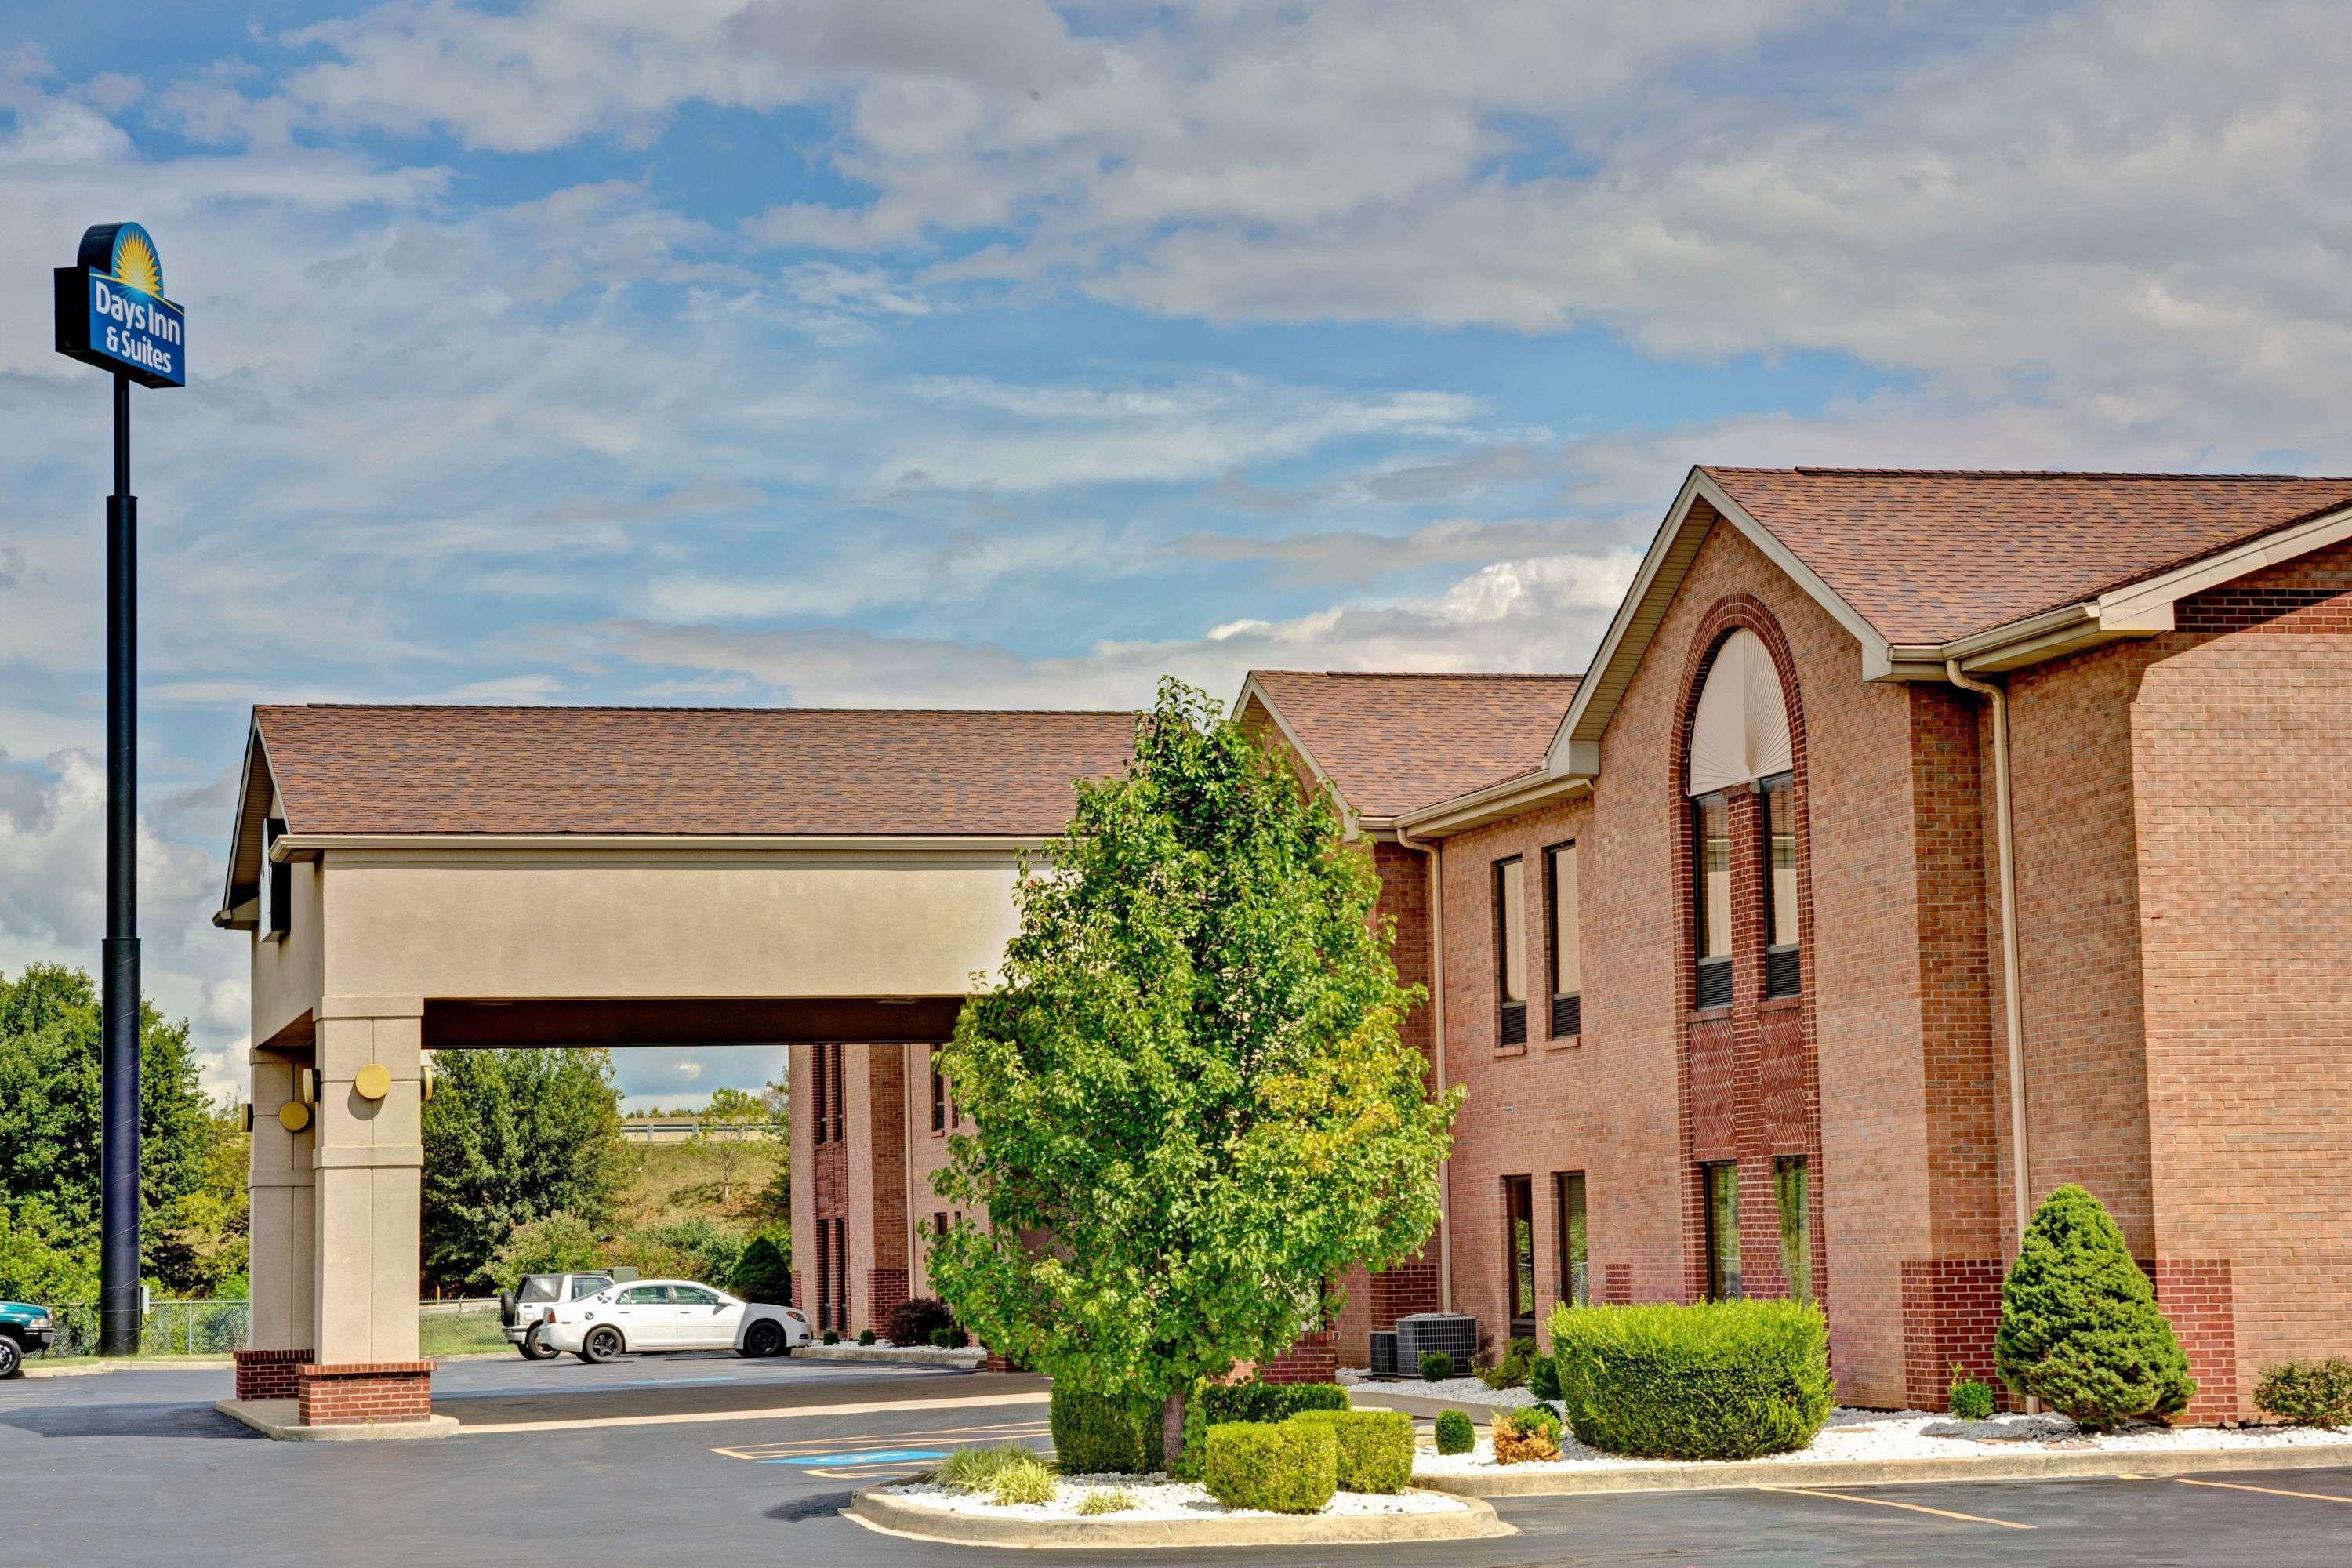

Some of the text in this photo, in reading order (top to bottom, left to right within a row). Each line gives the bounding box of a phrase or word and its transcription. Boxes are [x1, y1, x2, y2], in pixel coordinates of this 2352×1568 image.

[96, 281, 180, 345] Days Inn
[107, 326, 172, 374] & Suites
